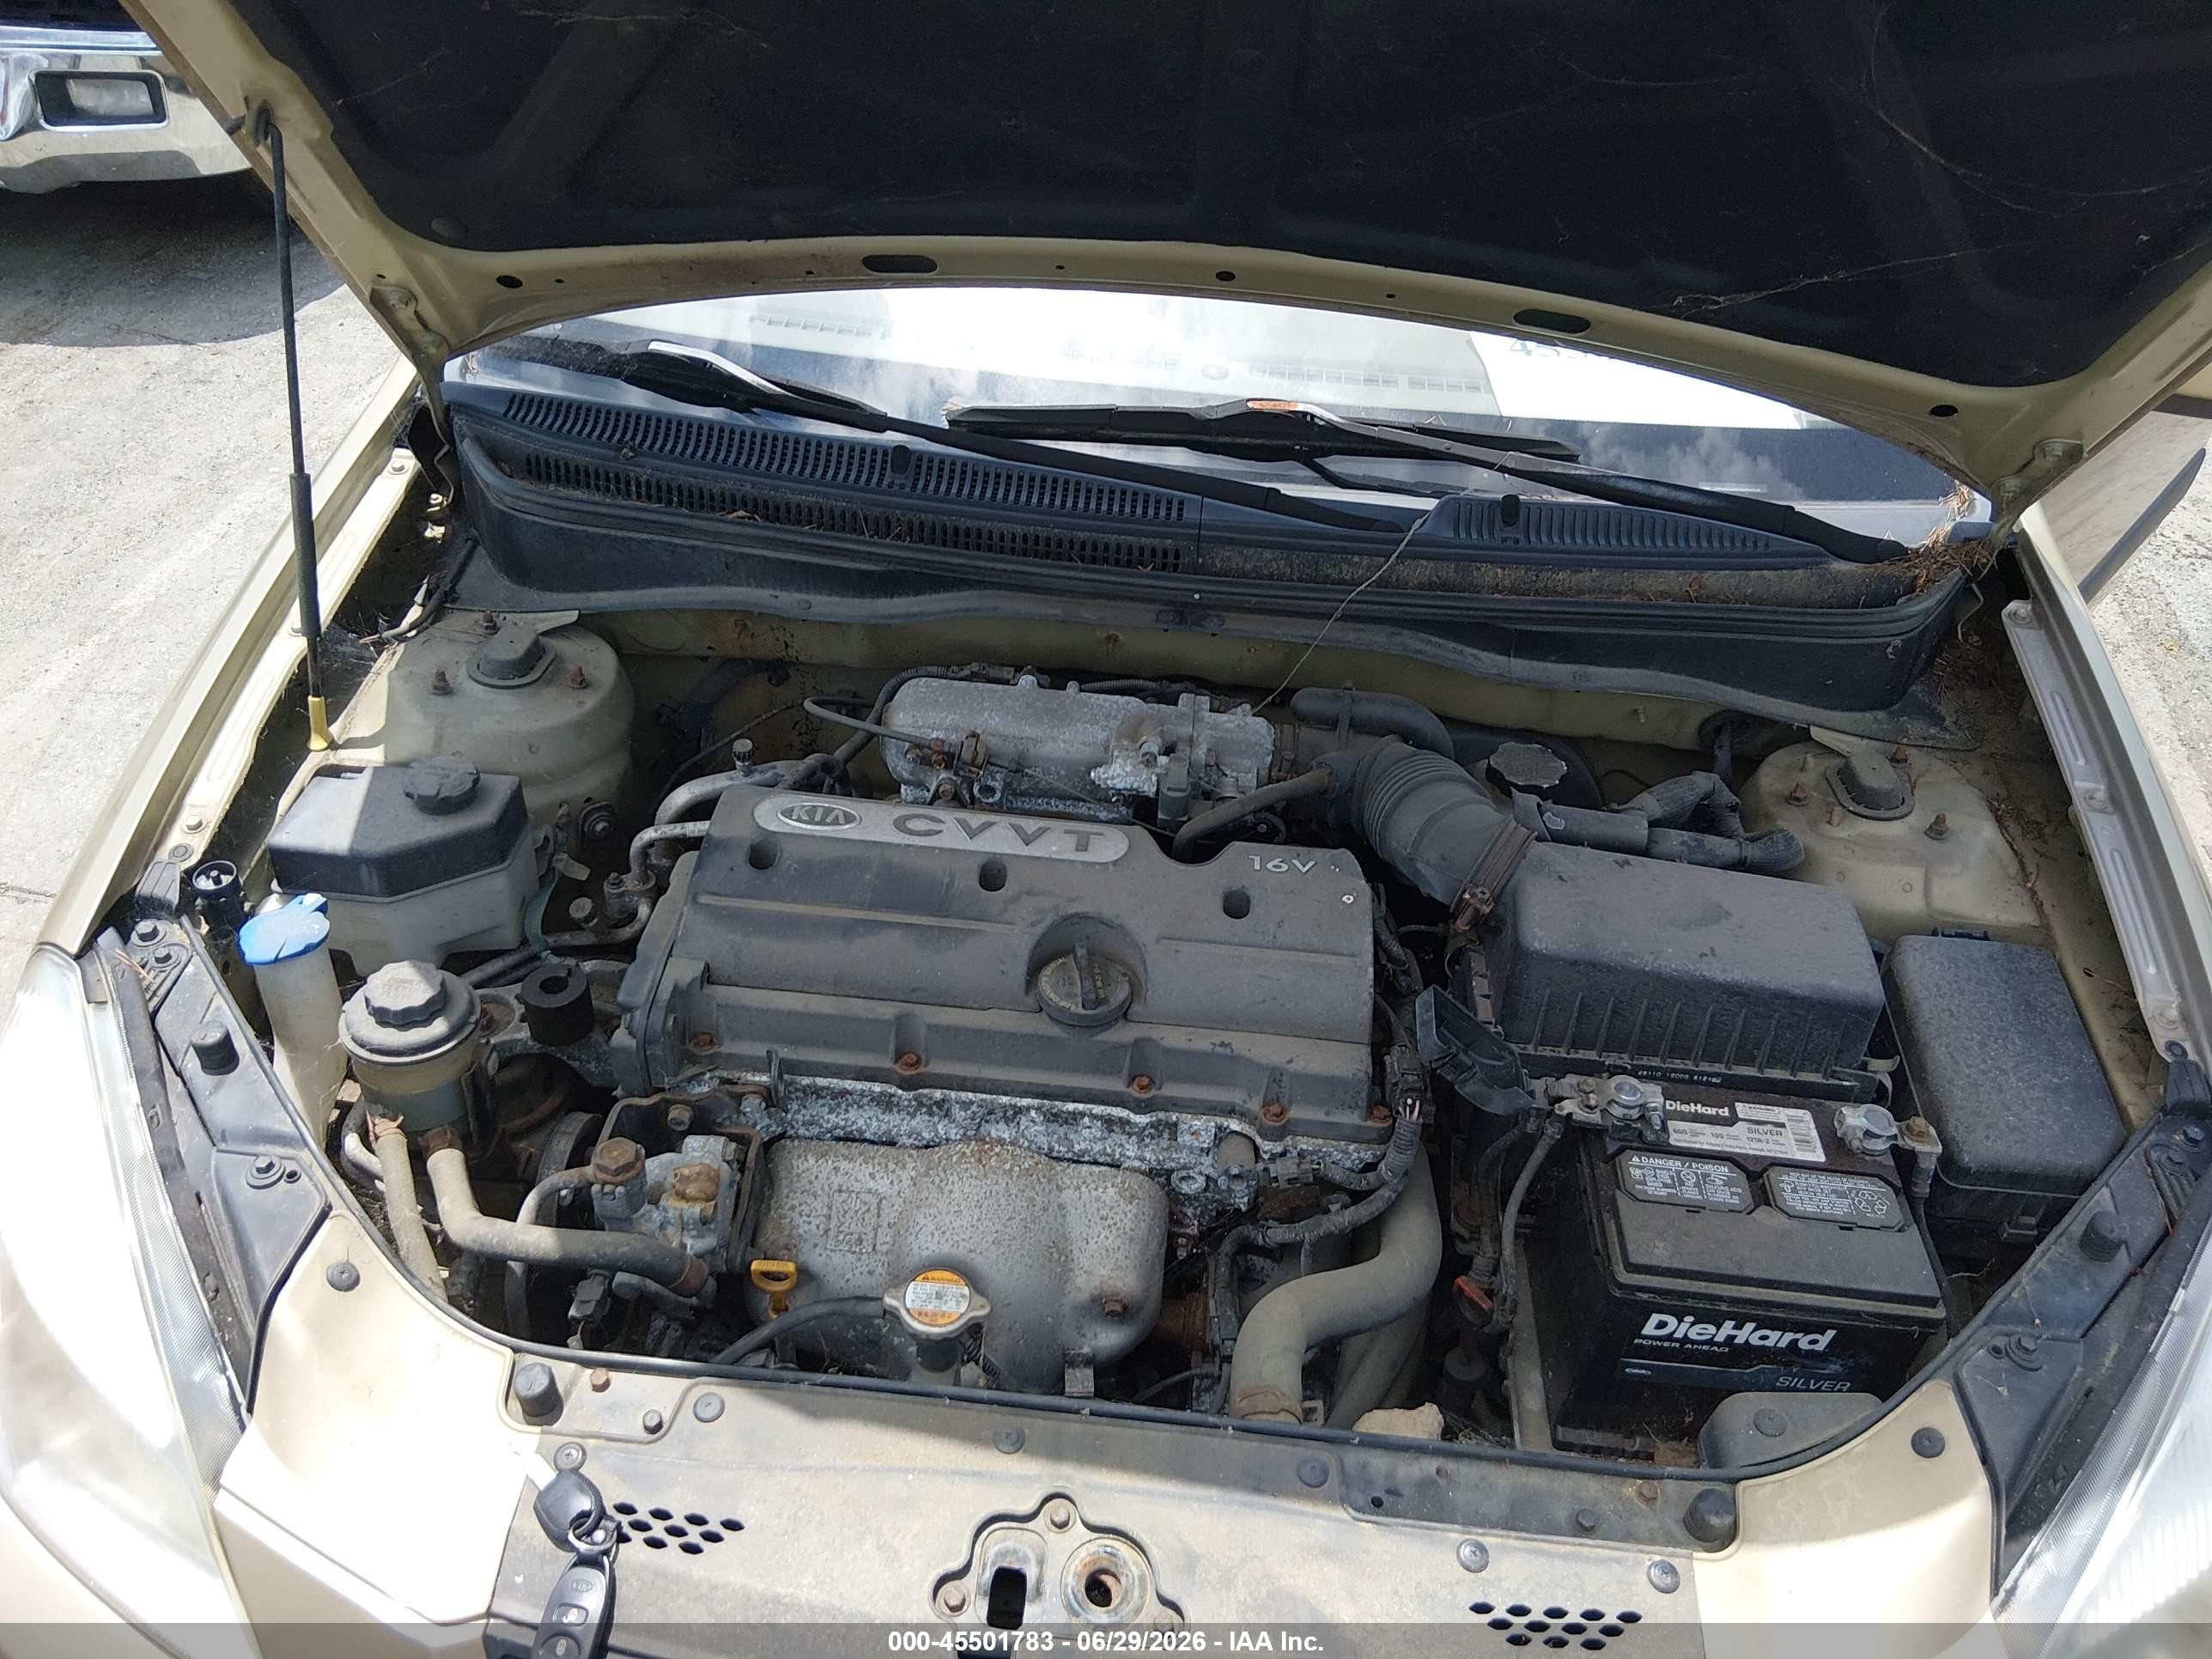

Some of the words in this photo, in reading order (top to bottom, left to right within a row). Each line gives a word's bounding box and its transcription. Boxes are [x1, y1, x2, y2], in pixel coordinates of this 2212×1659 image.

[791, 805, 846, 825] KIA
[892, 812, 1104, 852] CVVT
[1249, 854, 1317, 873] 16V
[1665, 1099, 1730, 1116] DieHard
[1747, 1127, 1783, 1137] SILVER
[1641, 1156, 1682, 1168] DANGER
[1692, 1162, 1729, 1173] POISON
[1641, 1313, 1837, 1351] DieHard
[1634, 1338, 1680, 1348] POWER
[1683, 1343, 1729, 1352] AHEAD
[1775, 1376, 1851, 1392] SILVER
